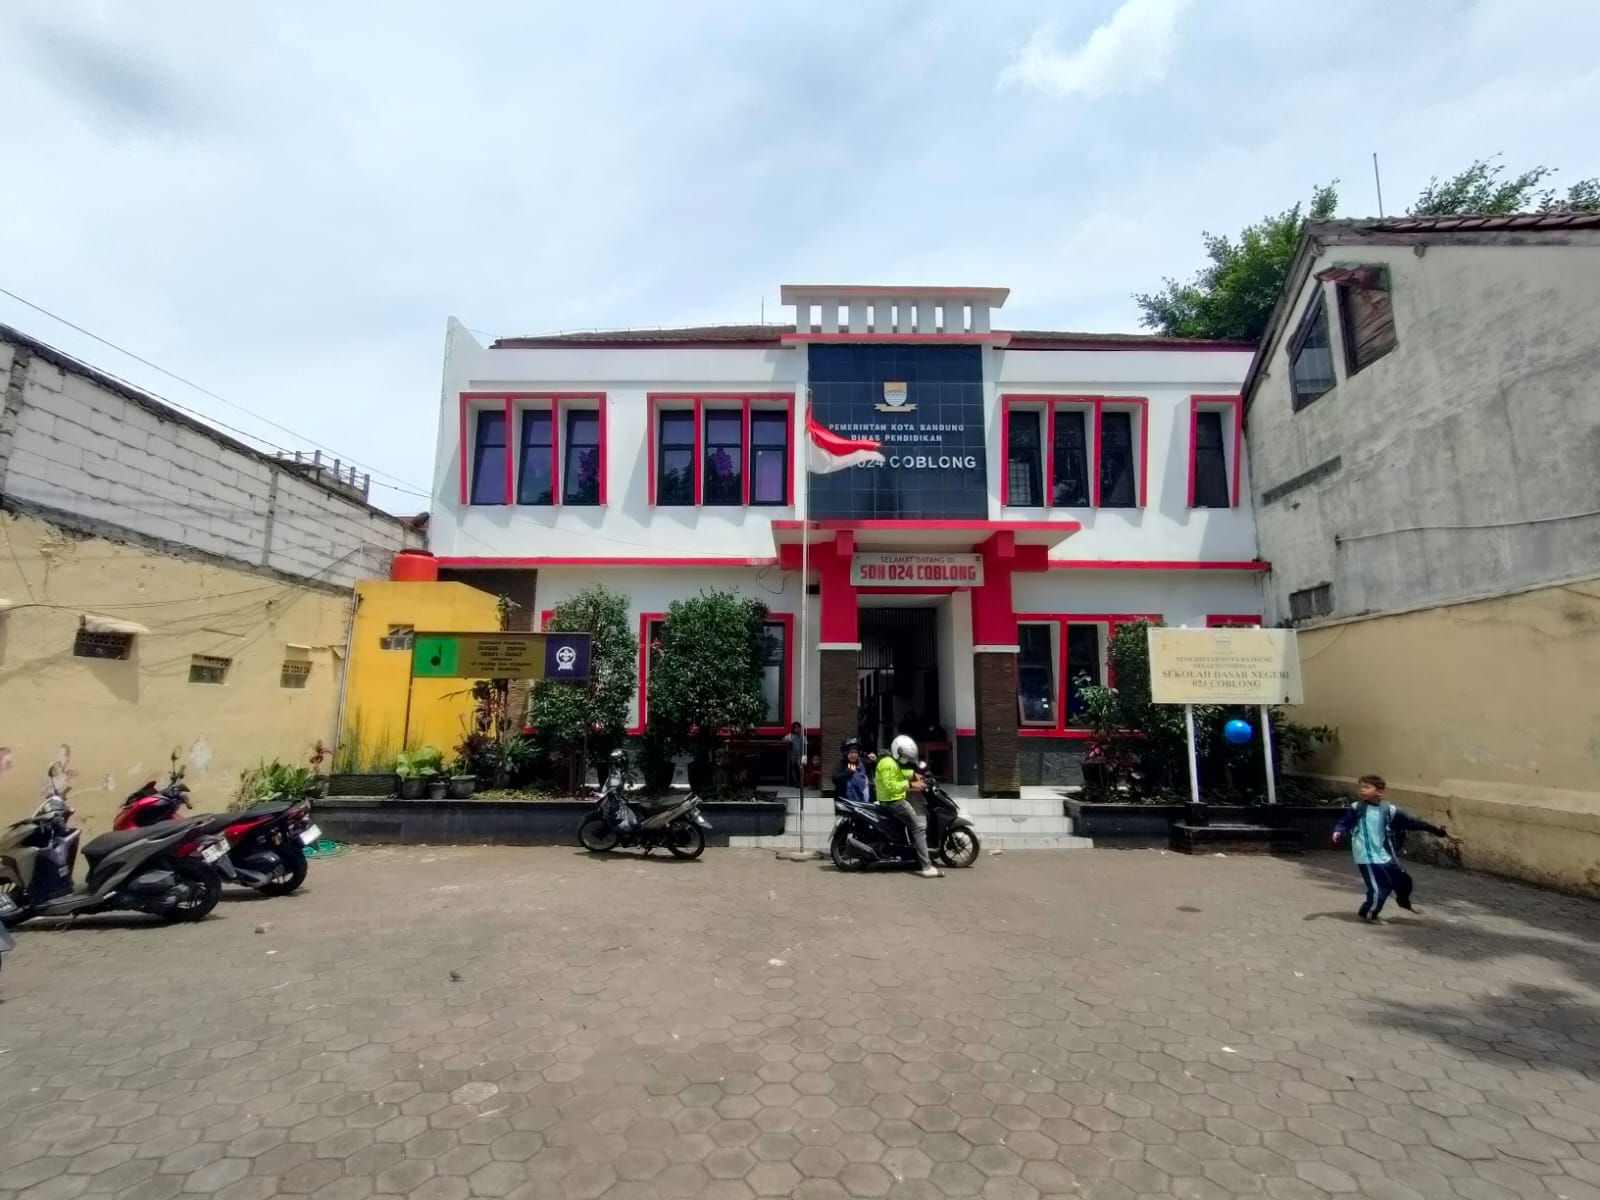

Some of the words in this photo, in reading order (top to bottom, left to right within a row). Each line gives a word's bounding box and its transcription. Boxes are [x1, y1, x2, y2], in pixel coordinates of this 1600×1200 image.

[828, 423, 887, 432] PEMERINTAH
[891, 423, 915, 432] KOTA
[919, 423, 965, 433] BANDUNG
[884, 434, 943, 442] PENDIDIKAN
[889, 456, 977, 469] COBLONG
[860, 564, 885, 579] SDN
[888, 564, 914, 580] 024
[916, 564, 977, 580] COBLONG
[1162, 670, 1212, 678] SEKOLAH
[1213, 670, 1249, 679] DASAR
[1251, 671, 1290, 679] NEGERI
[1210, 679, 1262, 688] COBLONG
